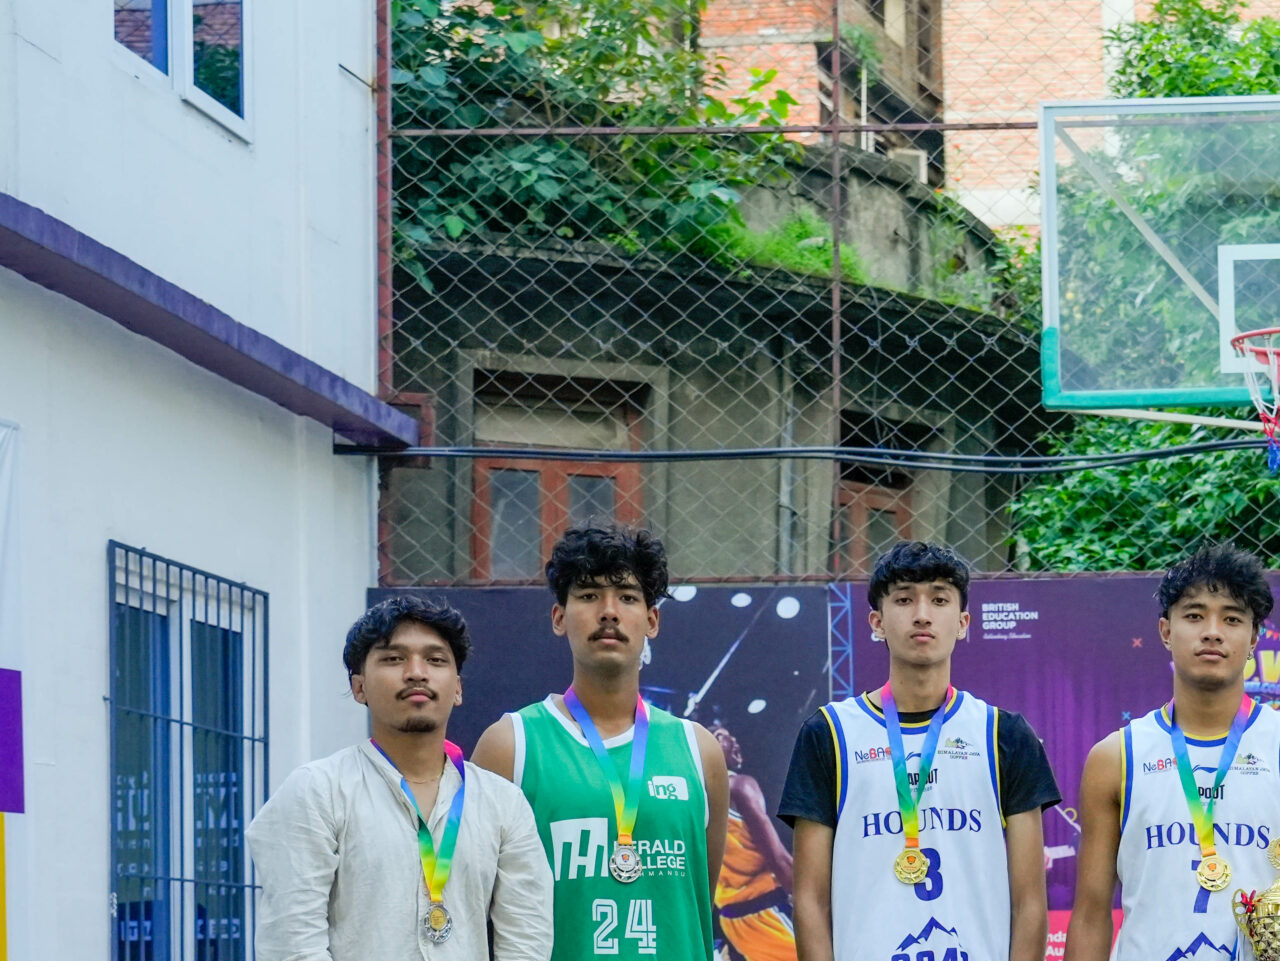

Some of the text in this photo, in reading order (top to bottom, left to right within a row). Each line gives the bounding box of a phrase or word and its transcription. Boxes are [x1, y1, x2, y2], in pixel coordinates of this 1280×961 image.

[982, 603, 1019, 611] BRITISH
[982, 611, 1039, 620] EDUCATION
[982, 621, 1017, 630] GROUP
[906, 768, 938, 786] APUT
[1197, 784, 1226, 800] POUT
[642, 855, 686, 870] LEGE
[914, 848, 943, 901] 3
[592, 898, 656, 955] 24
